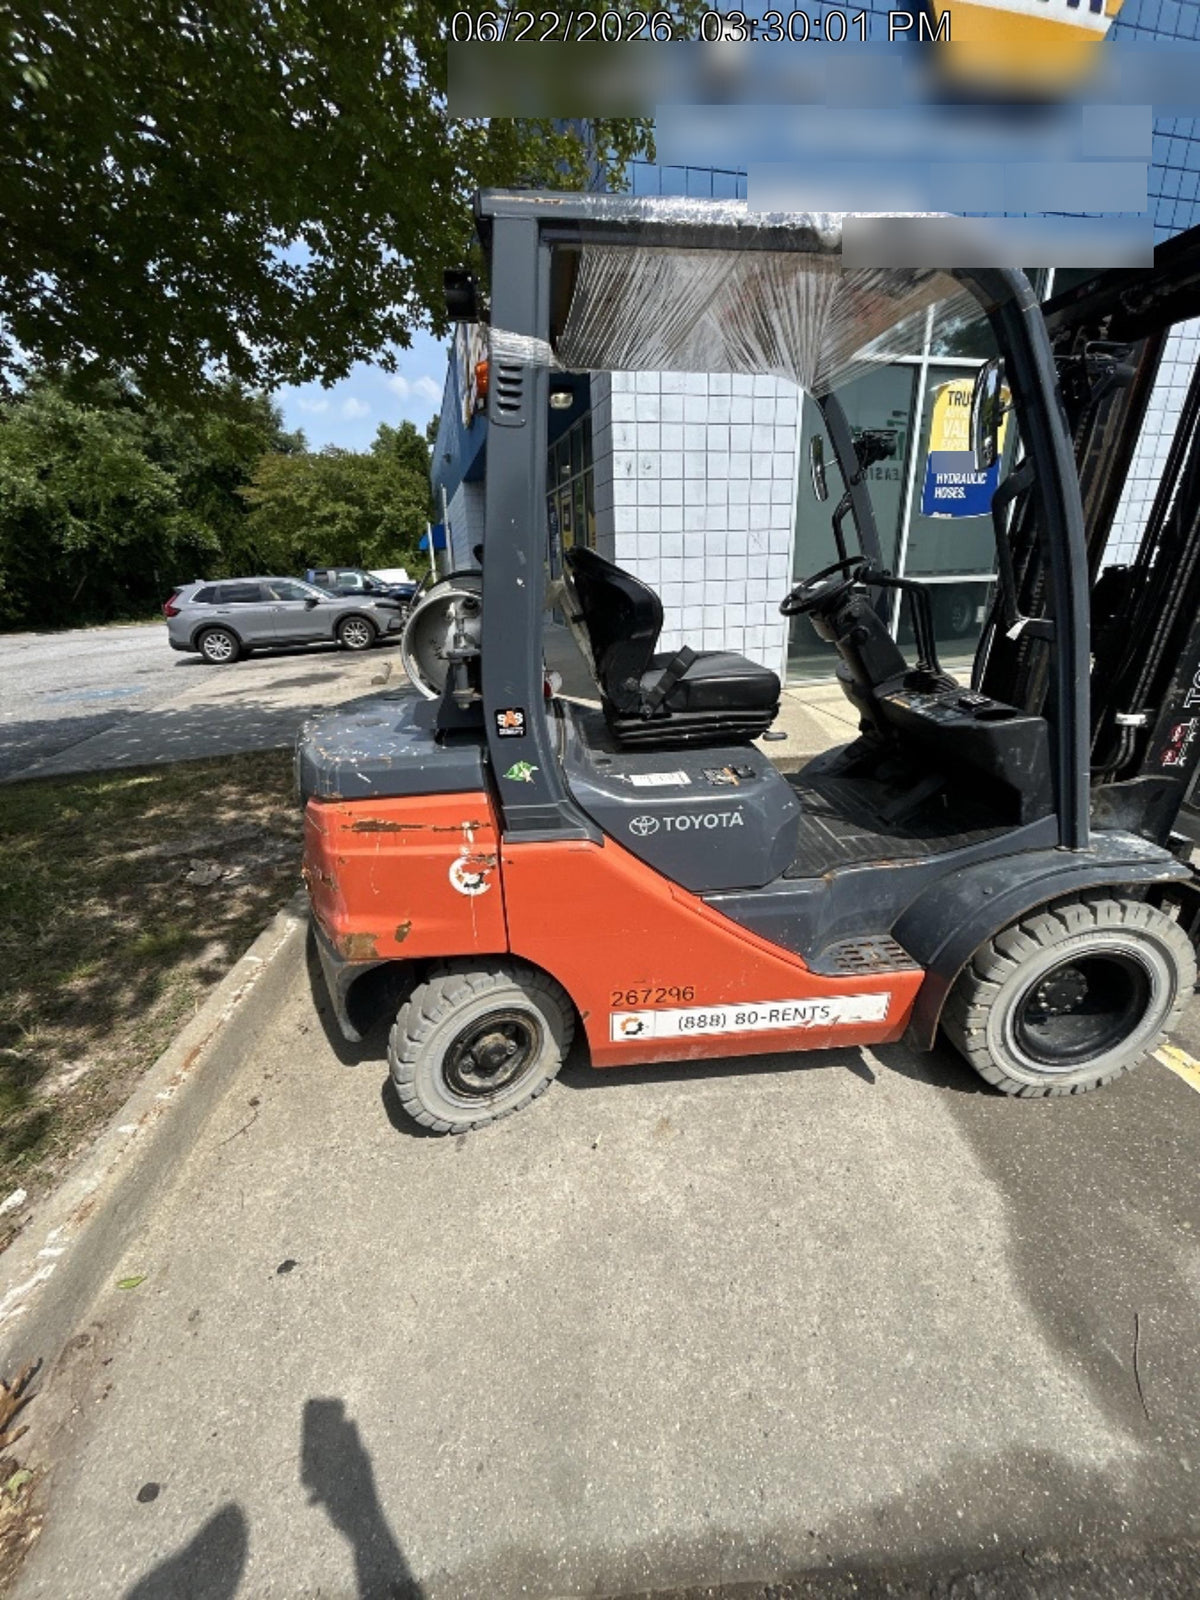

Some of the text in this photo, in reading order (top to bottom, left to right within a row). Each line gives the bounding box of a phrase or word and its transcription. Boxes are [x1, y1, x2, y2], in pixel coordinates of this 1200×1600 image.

[947, 391, 971, 406] TRU
[936, 472, 987, 484] HYDRAULIC
[934, 487, 966, 499] HOSES.
[663, 811, 744, 831] TOYOTA
[611, 985, 694, 1007] 267296
[678, 1005, 830, 1030] (888) 80-RENTS
